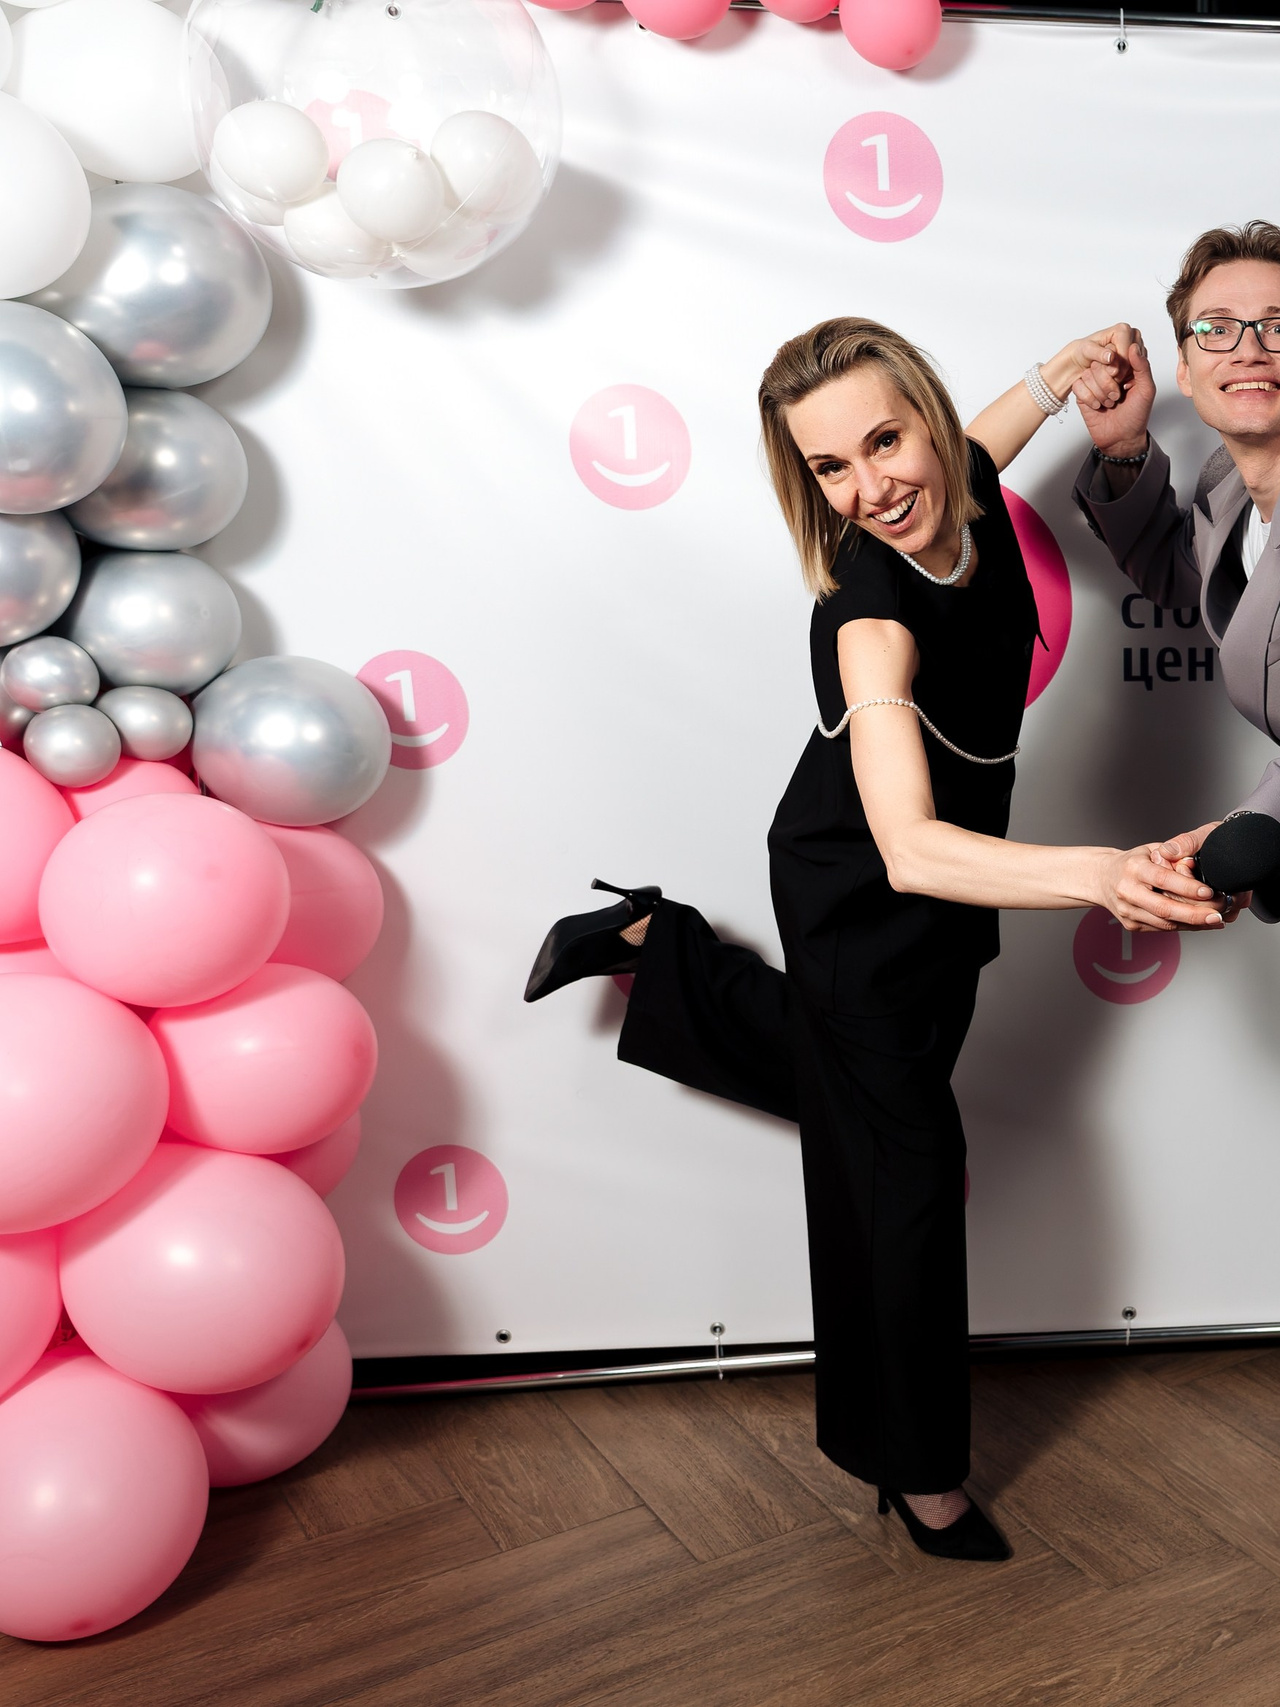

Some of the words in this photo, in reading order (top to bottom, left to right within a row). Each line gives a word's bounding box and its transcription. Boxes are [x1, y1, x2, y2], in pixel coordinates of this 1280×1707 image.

[861, 134, 890, 191] 1
[607, 405, 637, 459] 1
[384, 669, 416, 722] 1
[1123, 647, 1220, 691] цен
[430, 1163, 458, 1211] 1
